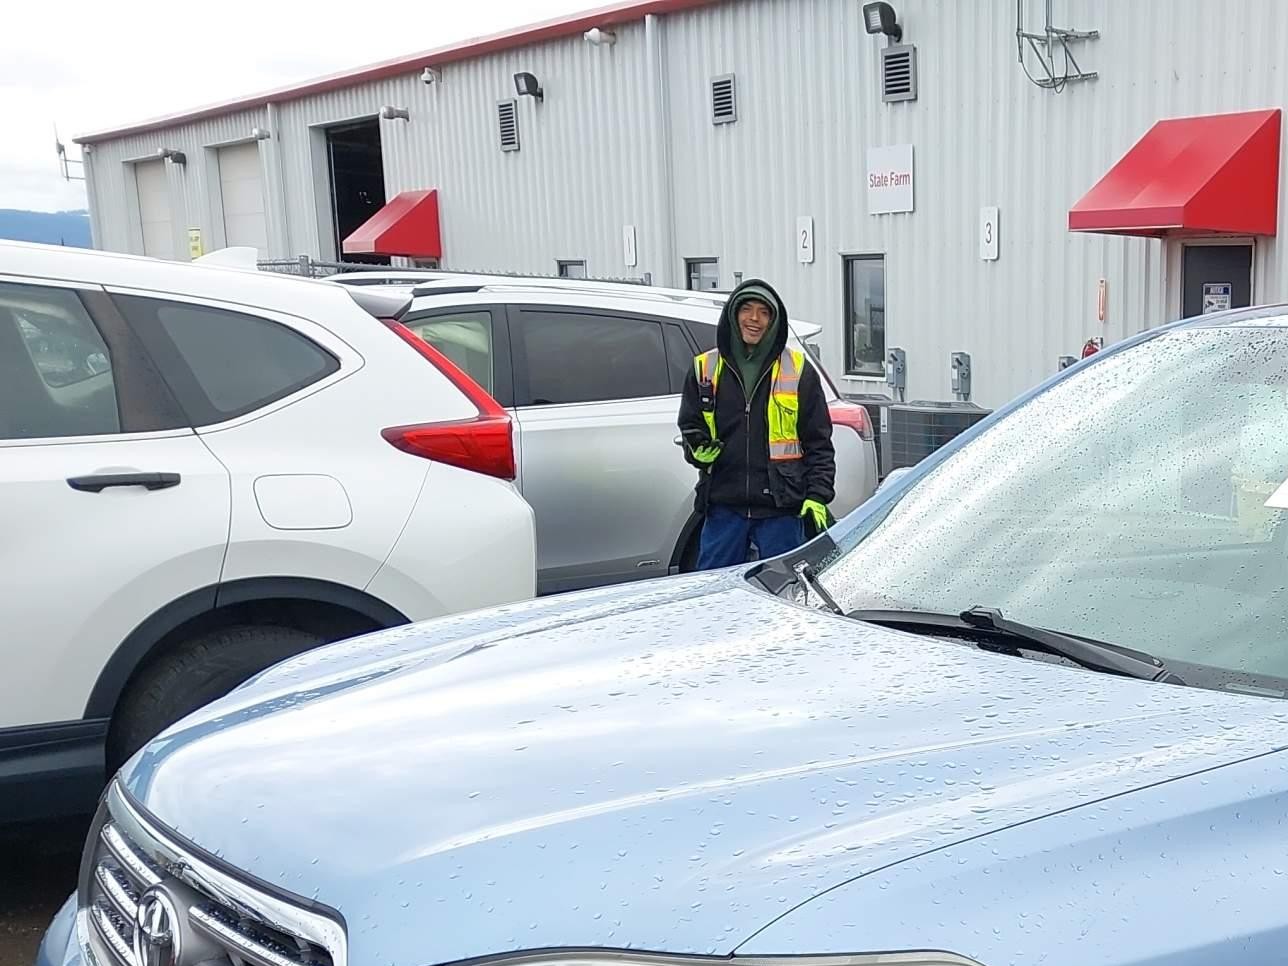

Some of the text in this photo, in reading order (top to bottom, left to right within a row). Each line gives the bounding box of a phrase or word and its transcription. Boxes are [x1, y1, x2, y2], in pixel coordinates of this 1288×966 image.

[869, 171, 910, 188] State Farm
[801, 229, 808, 249] 2
[985, 222, 992, 244] 3
